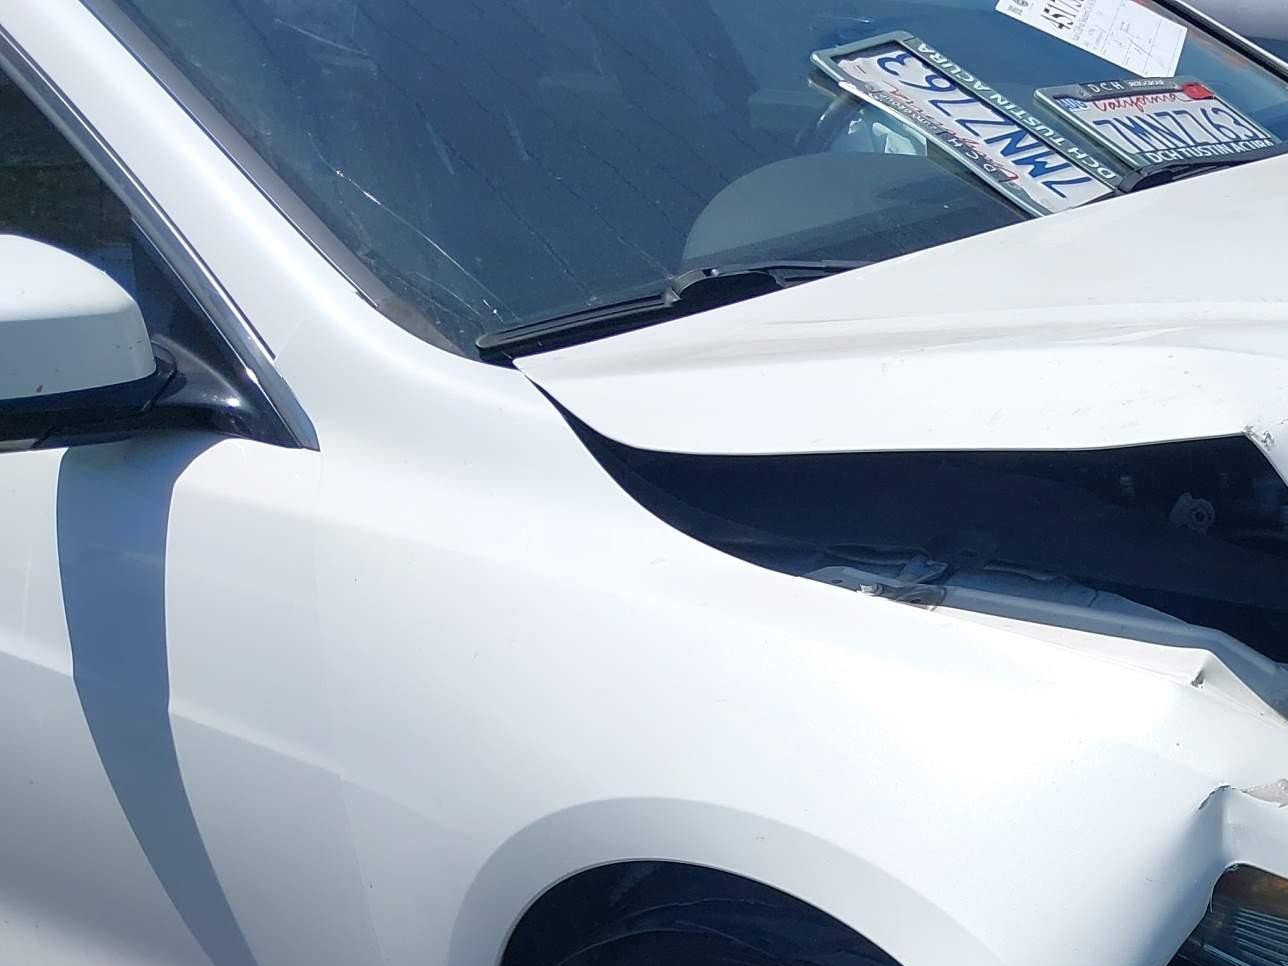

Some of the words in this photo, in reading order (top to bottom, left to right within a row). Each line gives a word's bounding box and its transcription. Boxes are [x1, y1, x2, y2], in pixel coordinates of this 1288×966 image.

[1040, 0, 1084, 29] 4517
[918, 43, 993, 91] ACURA
[1087, 80, 1125, 93] DCH
[1092, 92, 1180, 112] California
[877, 52, 1093, 198] 7MNZ763
[989, 93, 1066, 147] TUSTIN
[1092, 107, 1260, 153] 7MNZ763
[947, 138, 997, 173] DCH
[1066, 146, 1117, 180] DCH
[1146, 150, 1182, 164] DCH
[1181, 143, 1231, 159] TUSTIN
[1229, 138, 1275, 154] ACURA
